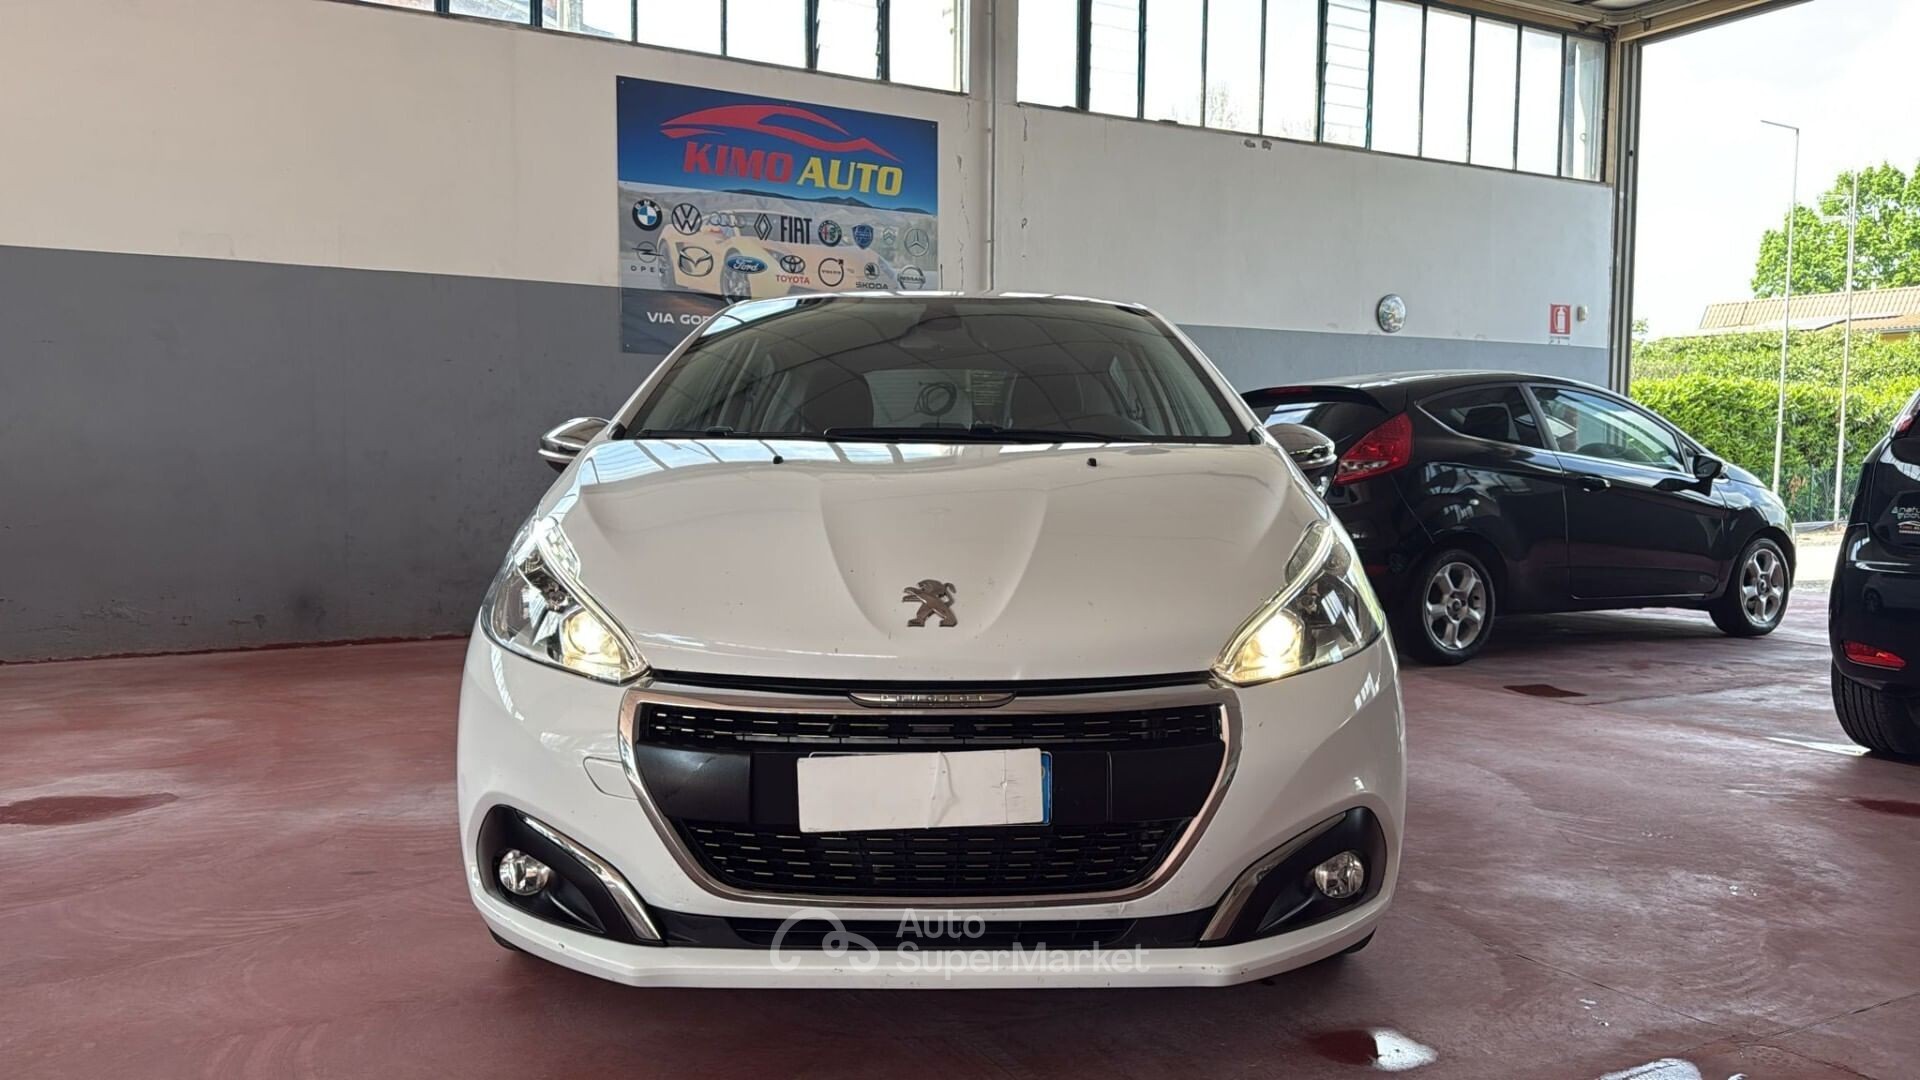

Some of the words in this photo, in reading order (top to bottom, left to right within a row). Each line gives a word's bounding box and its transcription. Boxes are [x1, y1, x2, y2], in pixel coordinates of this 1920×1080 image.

[683, 141, 793, 184] KIMO
[797, 156, 903, 197] AUTO
[780, 216, 812, 244] FIAT
[631, 265, 665, 274] OPEL
[733, 260, 759, 271] Ford
[776, 275, 810, 285] TOYOTA
[646, 312, 675, 324] VIA
